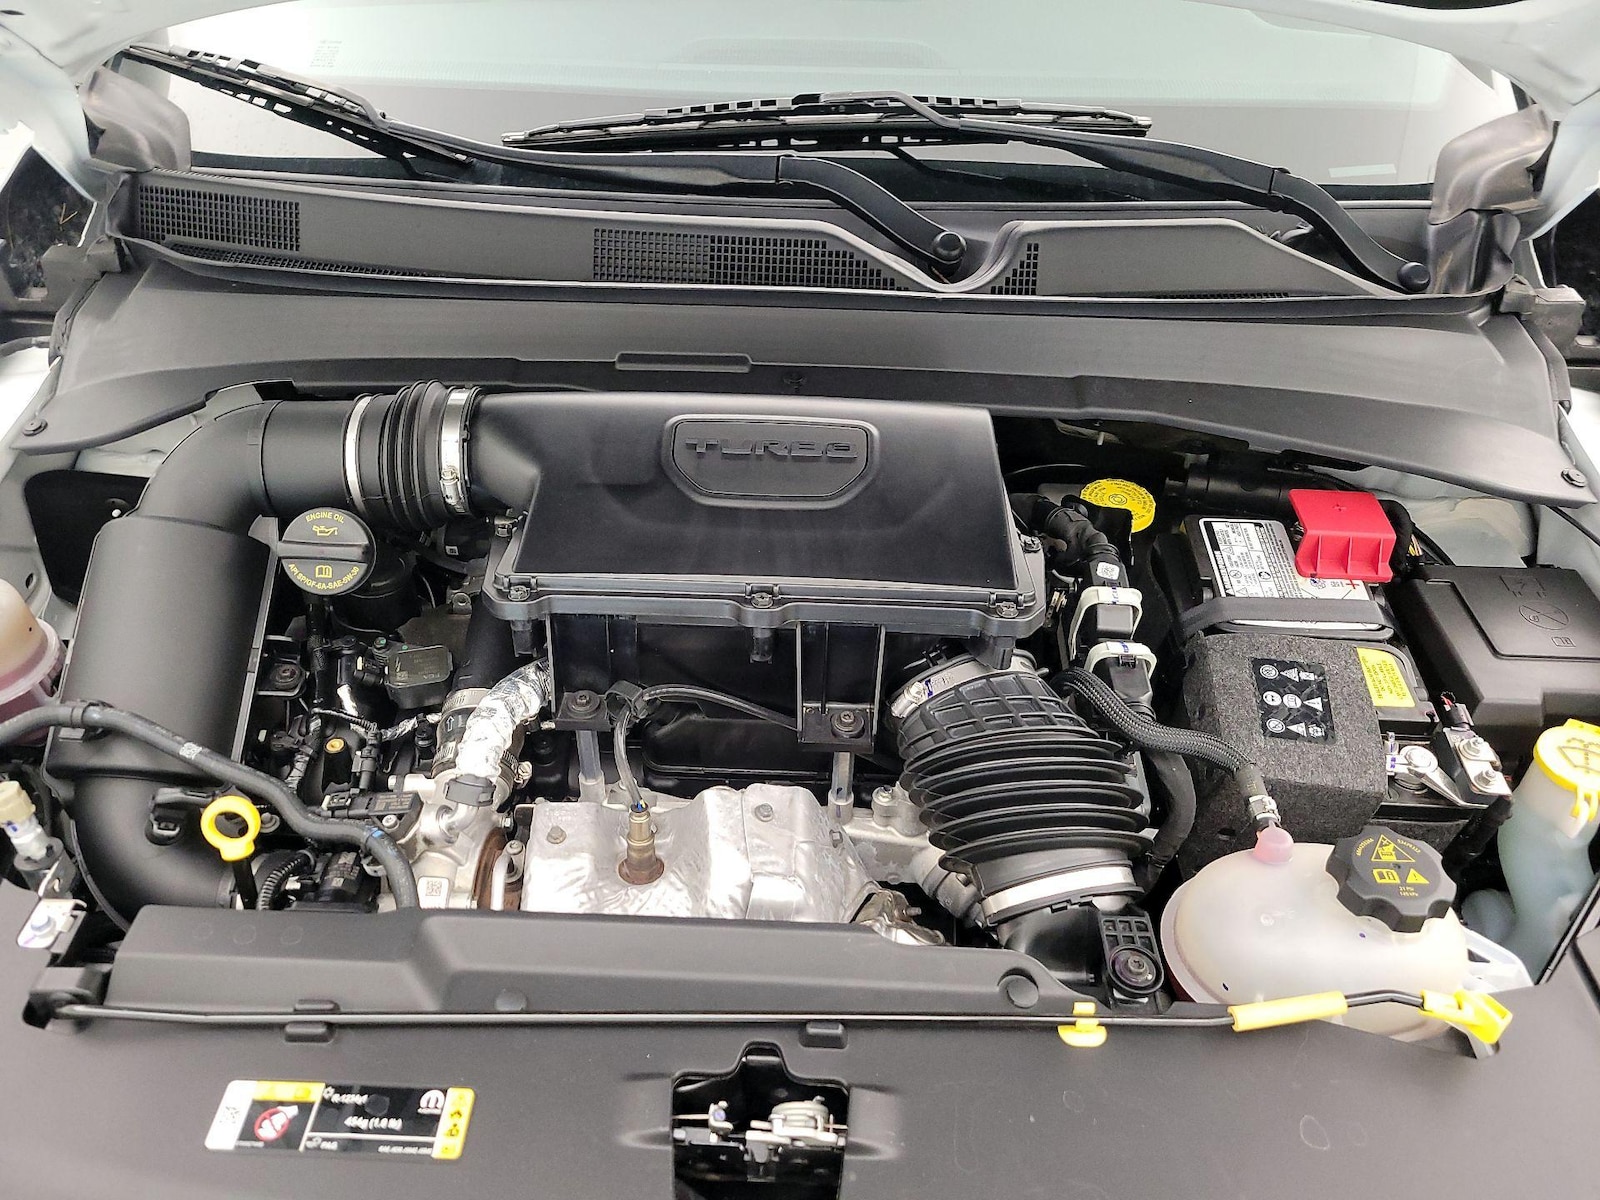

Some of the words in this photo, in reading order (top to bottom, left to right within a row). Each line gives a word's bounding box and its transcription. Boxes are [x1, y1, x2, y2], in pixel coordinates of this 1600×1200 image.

[685, 437, 858, 458] TURBO
[305, 511, 333, 523] ENGINE
[333, 514, 345, 524] OIL
[288, 563, 298, 576] API
